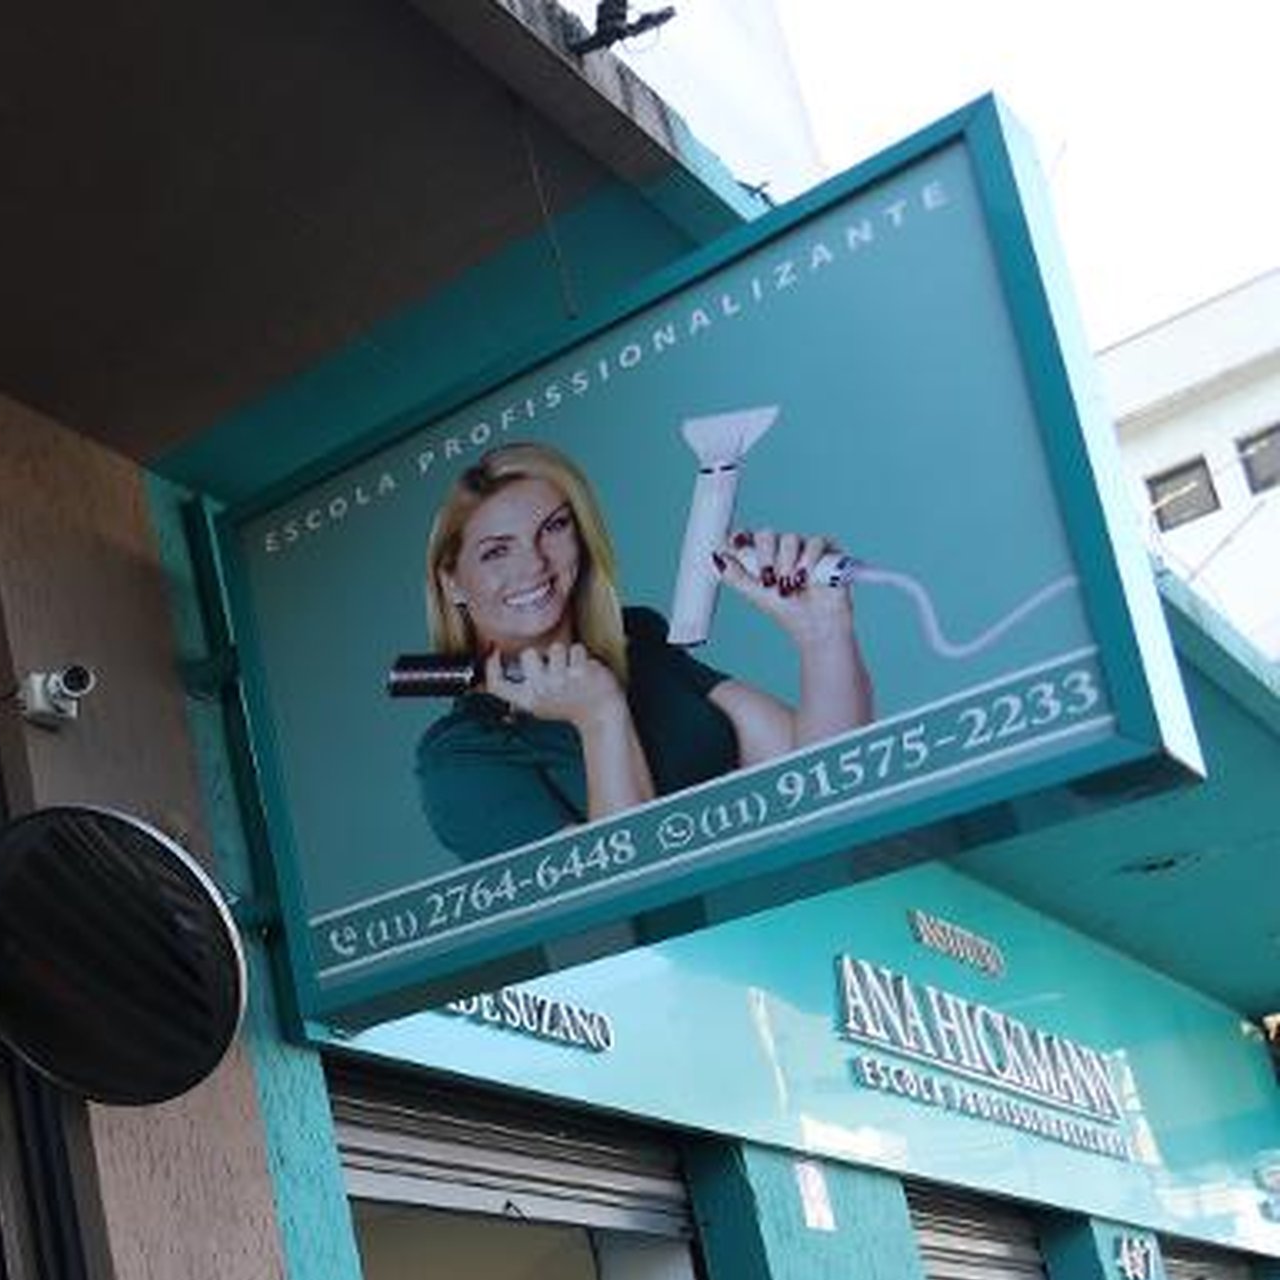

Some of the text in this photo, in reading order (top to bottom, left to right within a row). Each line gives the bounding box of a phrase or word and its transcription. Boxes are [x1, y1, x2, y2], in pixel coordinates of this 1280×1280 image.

[265, 179, 950, 553] ESCOLA PROFISSIONALIZANTE
[365, 670, 1100, 949] (11) 2764-6448 (11) 91575-2233
[502, 986, 616, 1051] SUZANO
[840, 953, 936, 1054] ANA
